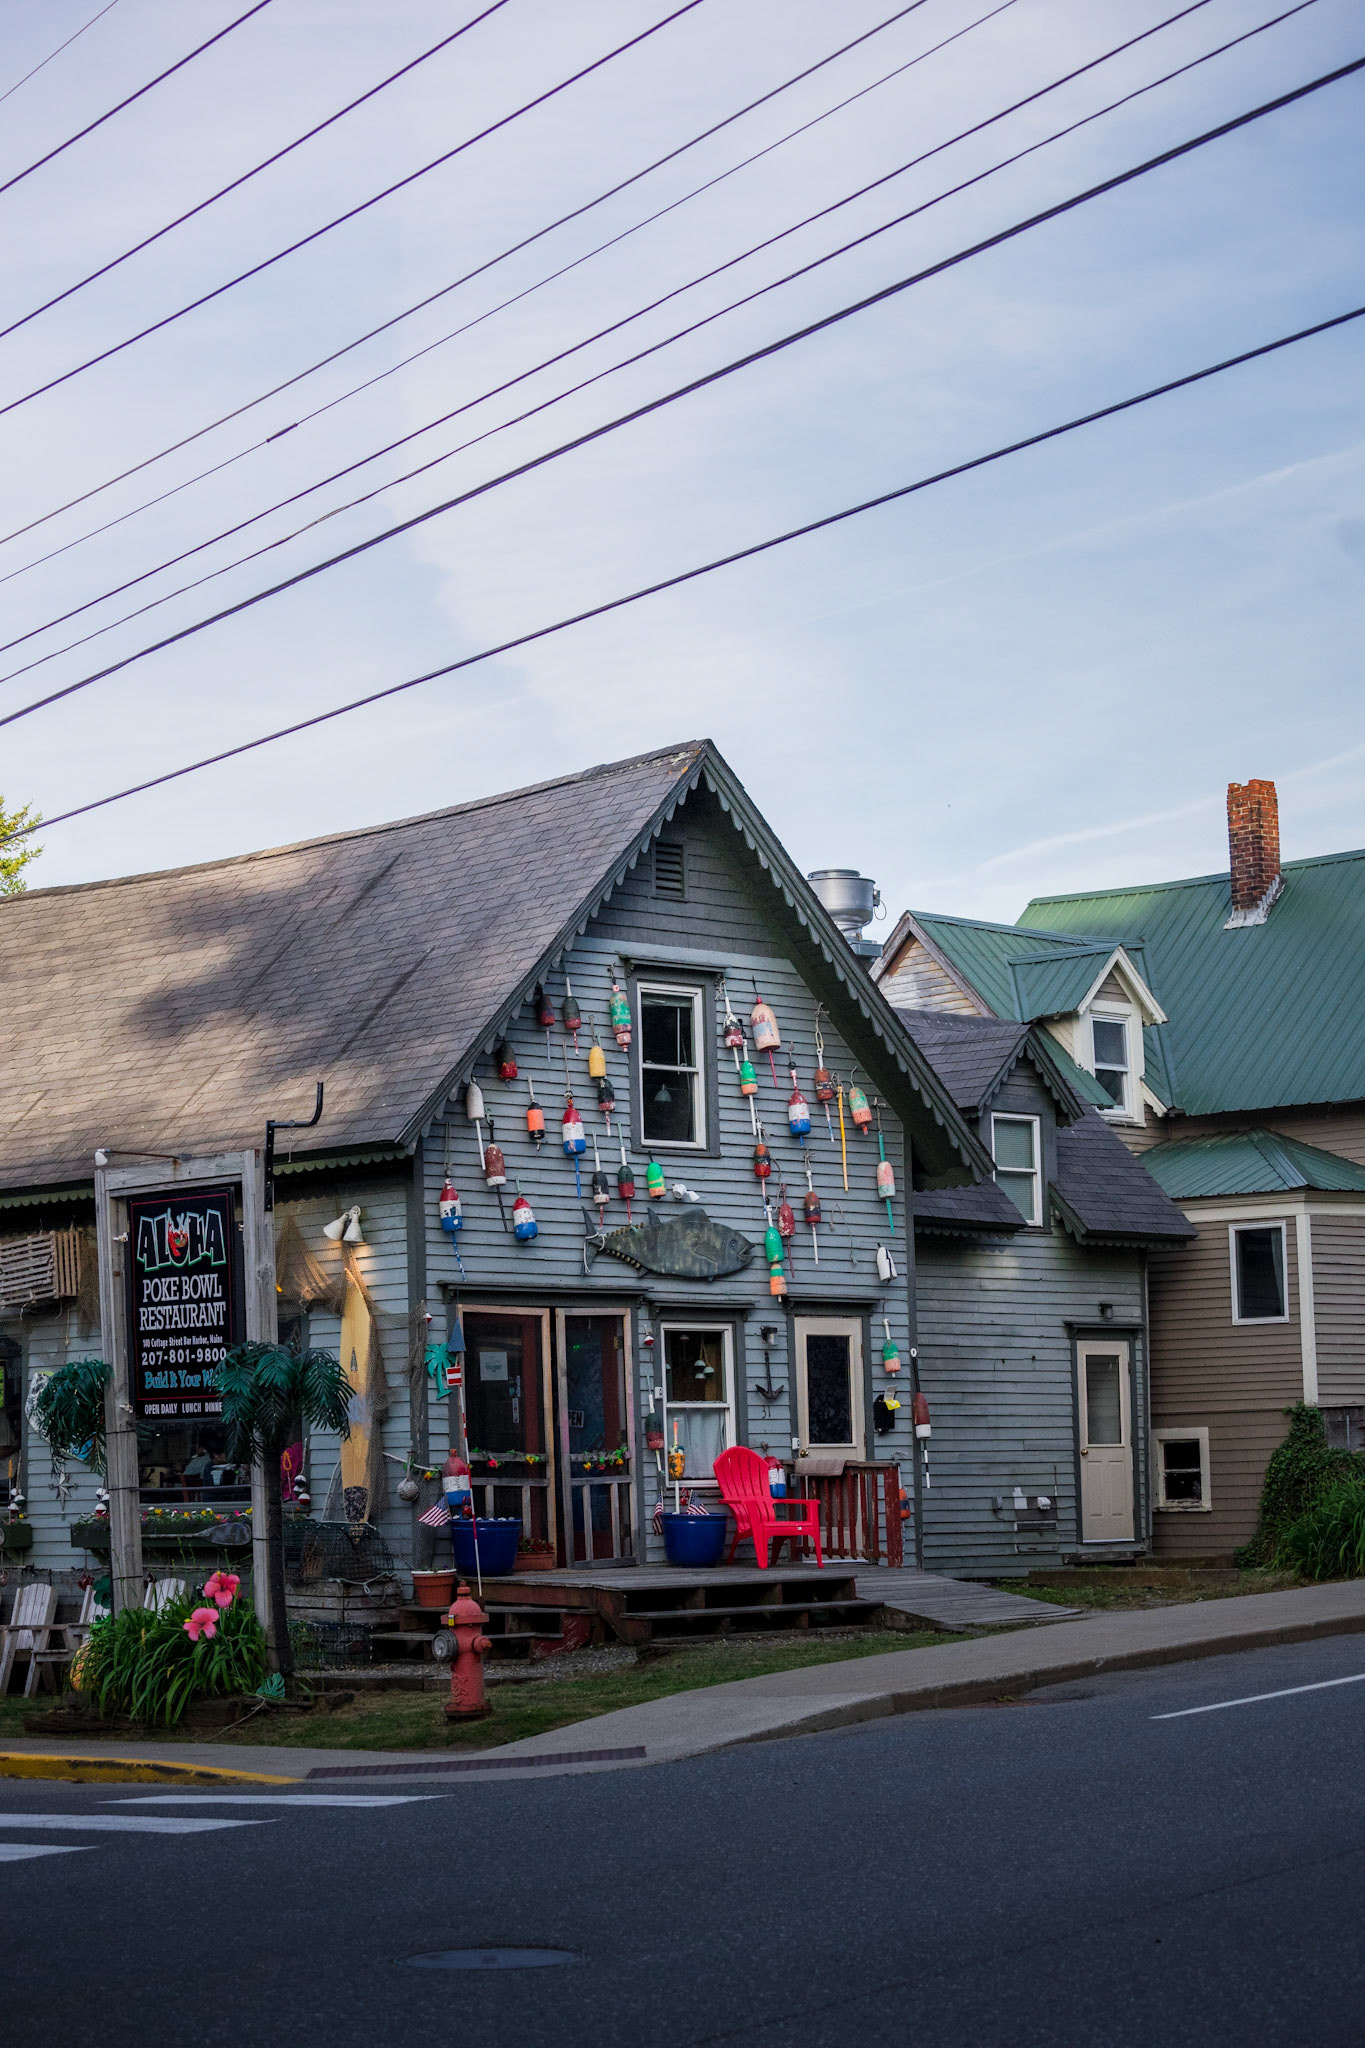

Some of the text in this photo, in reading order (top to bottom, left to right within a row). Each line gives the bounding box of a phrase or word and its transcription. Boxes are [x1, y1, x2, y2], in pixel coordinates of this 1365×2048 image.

[136, 1207, 227, 1273] ALOHA
[142, 1273, 222, 1303] POKE BOWL
[139, 1301, 226, 1331] RESTAURANT
[151, 1337, 168, 1349] Cottage
[169, 1334, 183, 1347] Street
[184, 1335, 192, 1346] Bar
[210, 1333, 223, 1344] Maine
[141, 1346, 227, 1366] 207-801-9800
[144, 1370, 169, 1390] Build
[169, 1370, 178, 1389] It
[178, 1369, 202, 1388] Your
[144, 1401, 222, 1415] OPEN DAILY LUNCH DINNE
